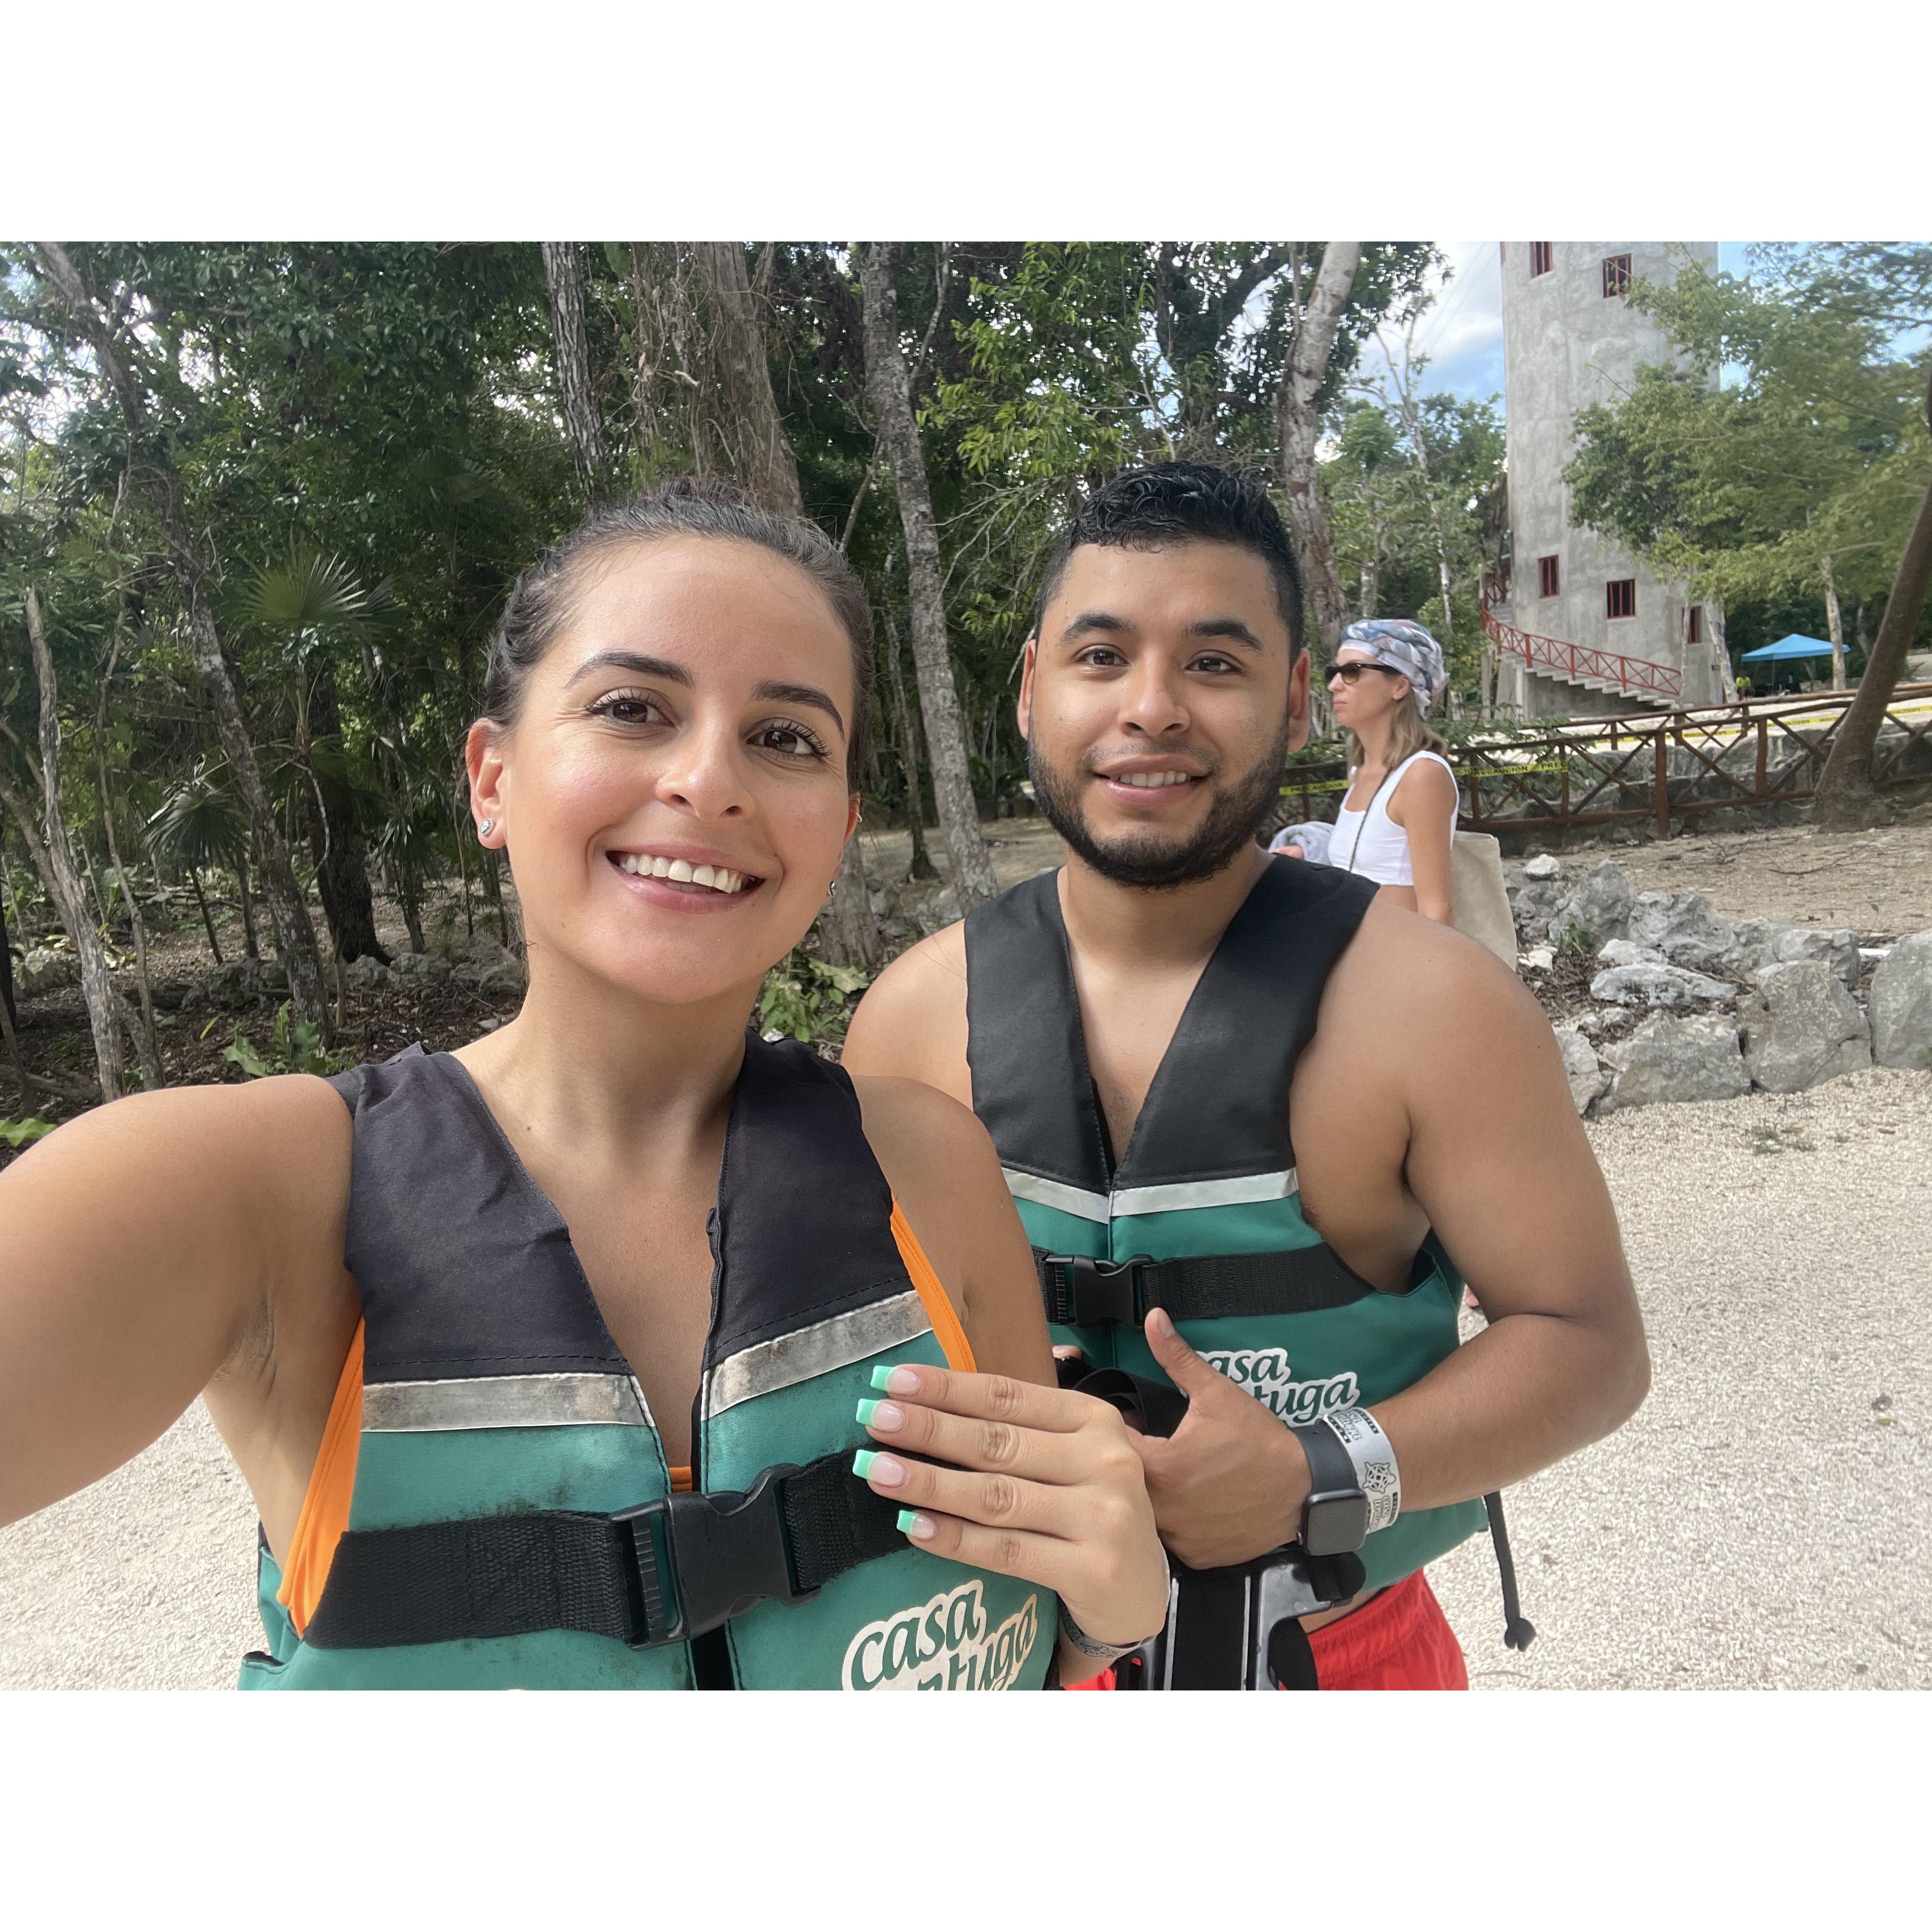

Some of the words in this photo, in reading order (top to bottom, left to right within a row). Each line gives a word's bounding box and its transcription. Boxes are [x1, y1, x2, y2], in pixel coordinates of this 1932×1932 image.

[1207, 1354, 1284, 1384] asa
[1254, 1378, 1355, 1424] tuga
[848, 1587, 983, 1690] casa
[917, 1600, 1037, 1690] tuga
